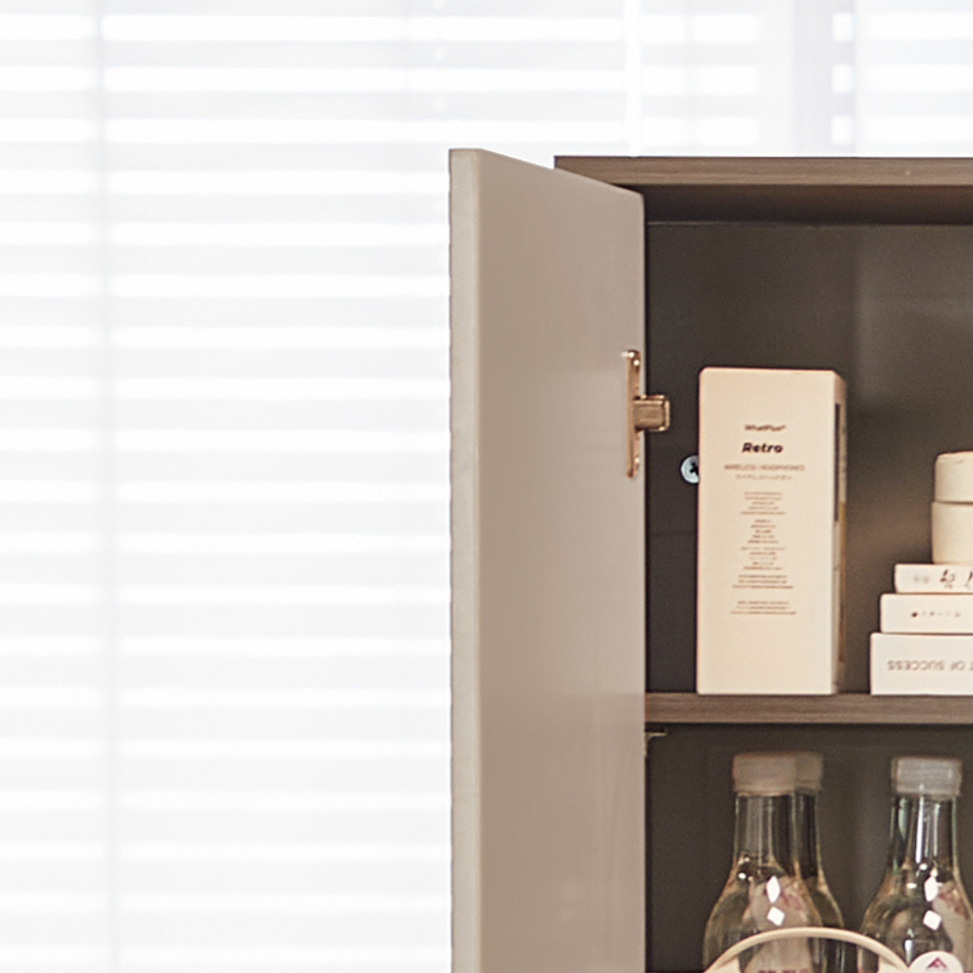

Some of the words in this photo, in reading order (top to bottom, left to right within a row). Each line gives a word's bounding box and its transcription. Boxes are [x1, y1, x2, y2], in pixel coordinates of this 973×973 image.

[741, 442, 784, 454] Retro
[886, 659, 945, 672] SUCCESS
[949, 660, 966, 672] OF
